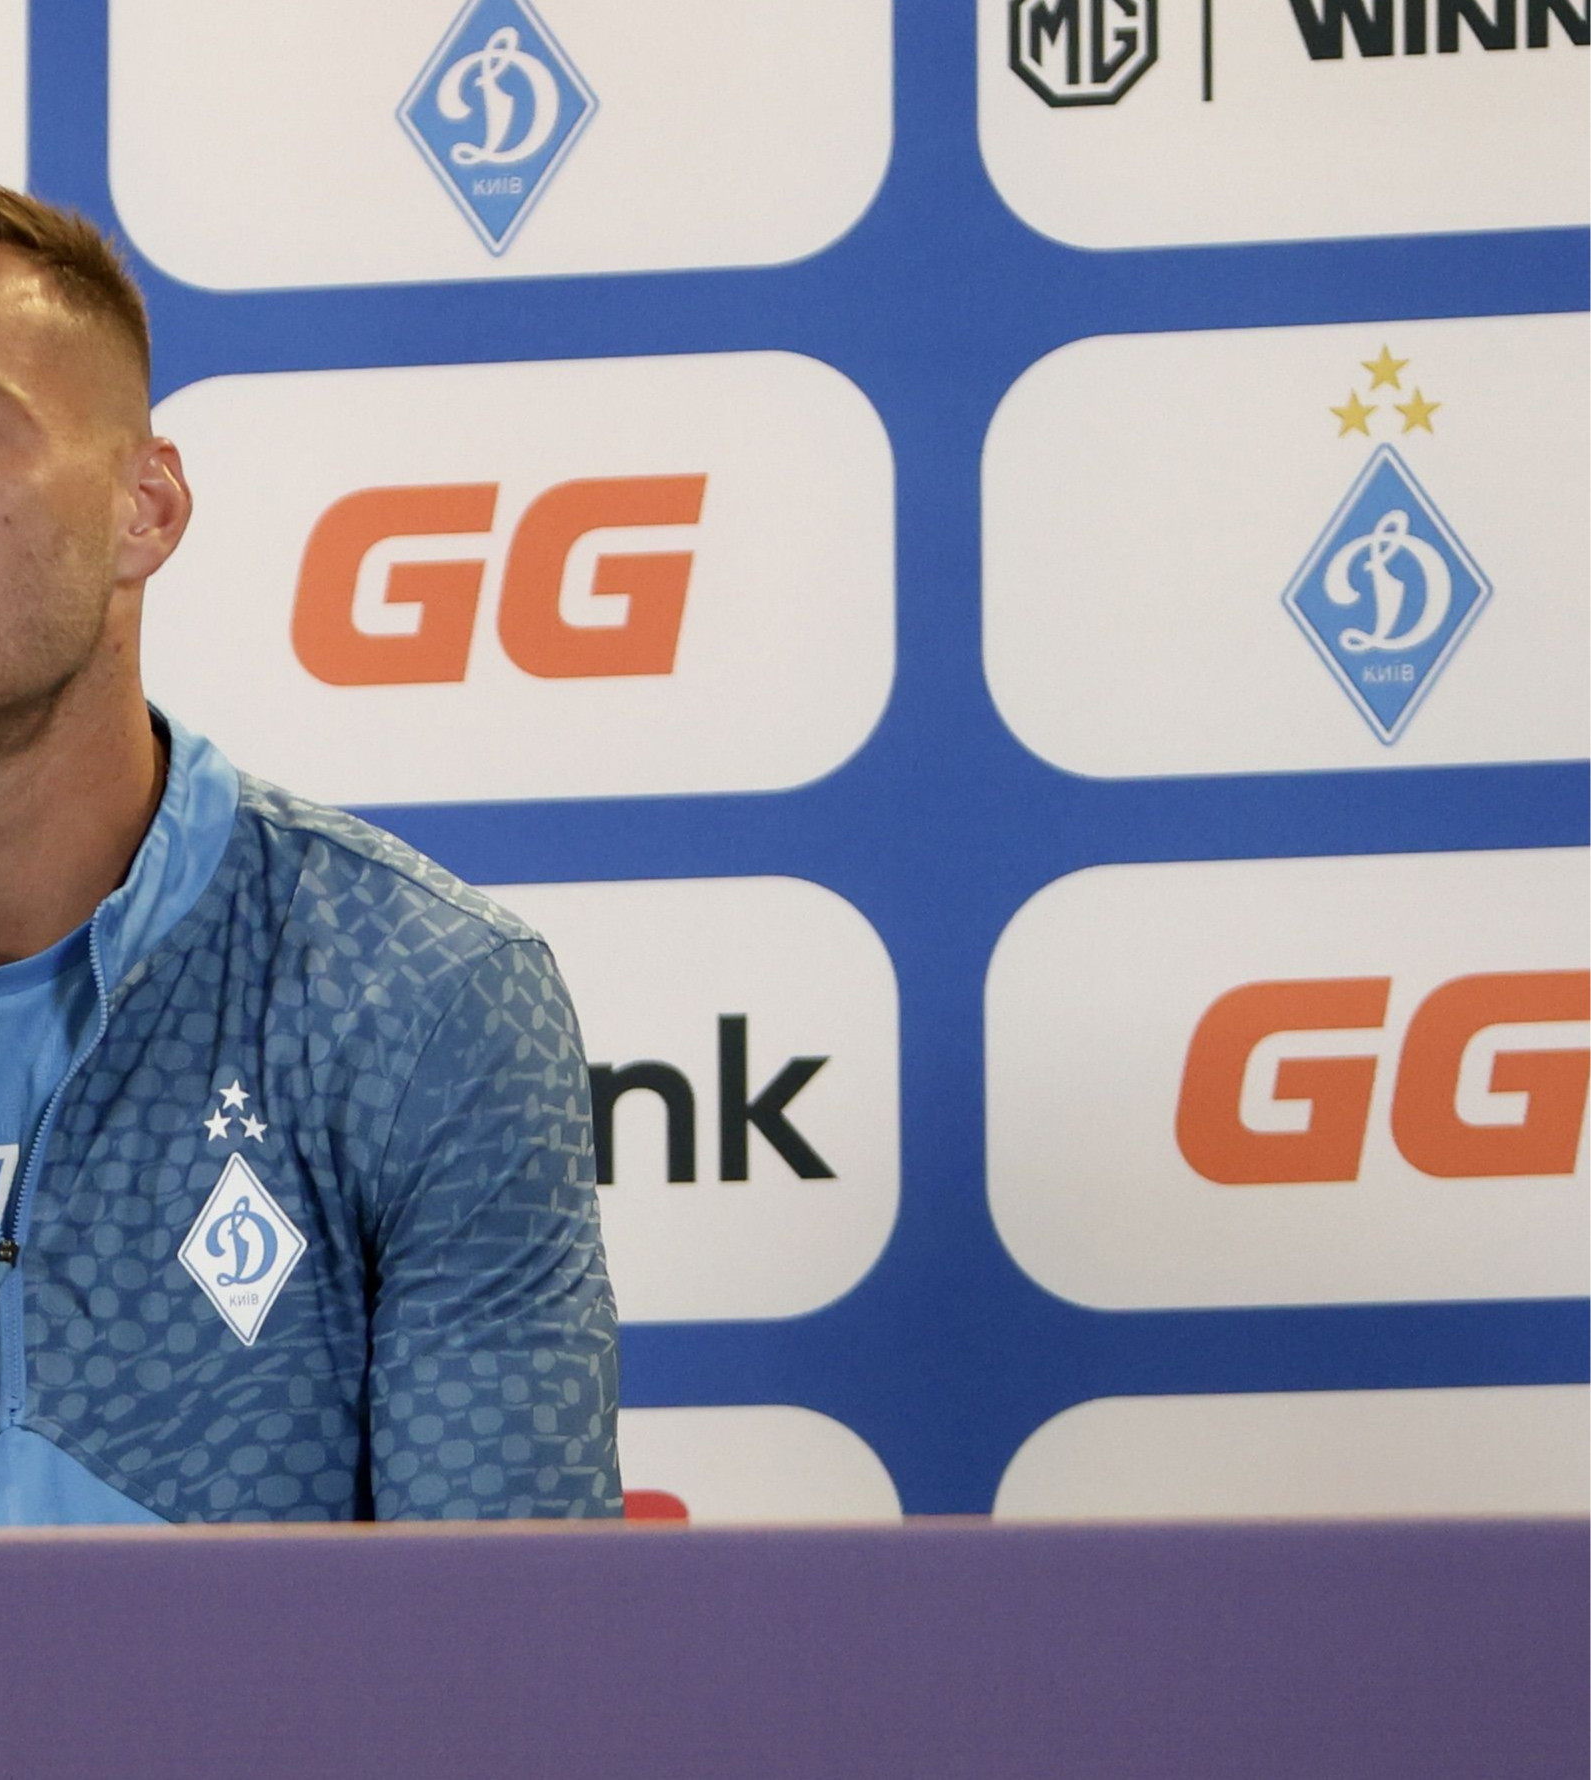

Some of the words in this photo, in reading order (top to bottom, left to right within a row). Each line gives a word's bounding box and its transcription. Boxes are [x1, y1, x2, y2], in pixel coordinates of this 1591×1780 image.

[1028, 0, 1141, 86] MG
[290, 473, 708, 687] GG
[1174, 969, 1591, 1186] GG
